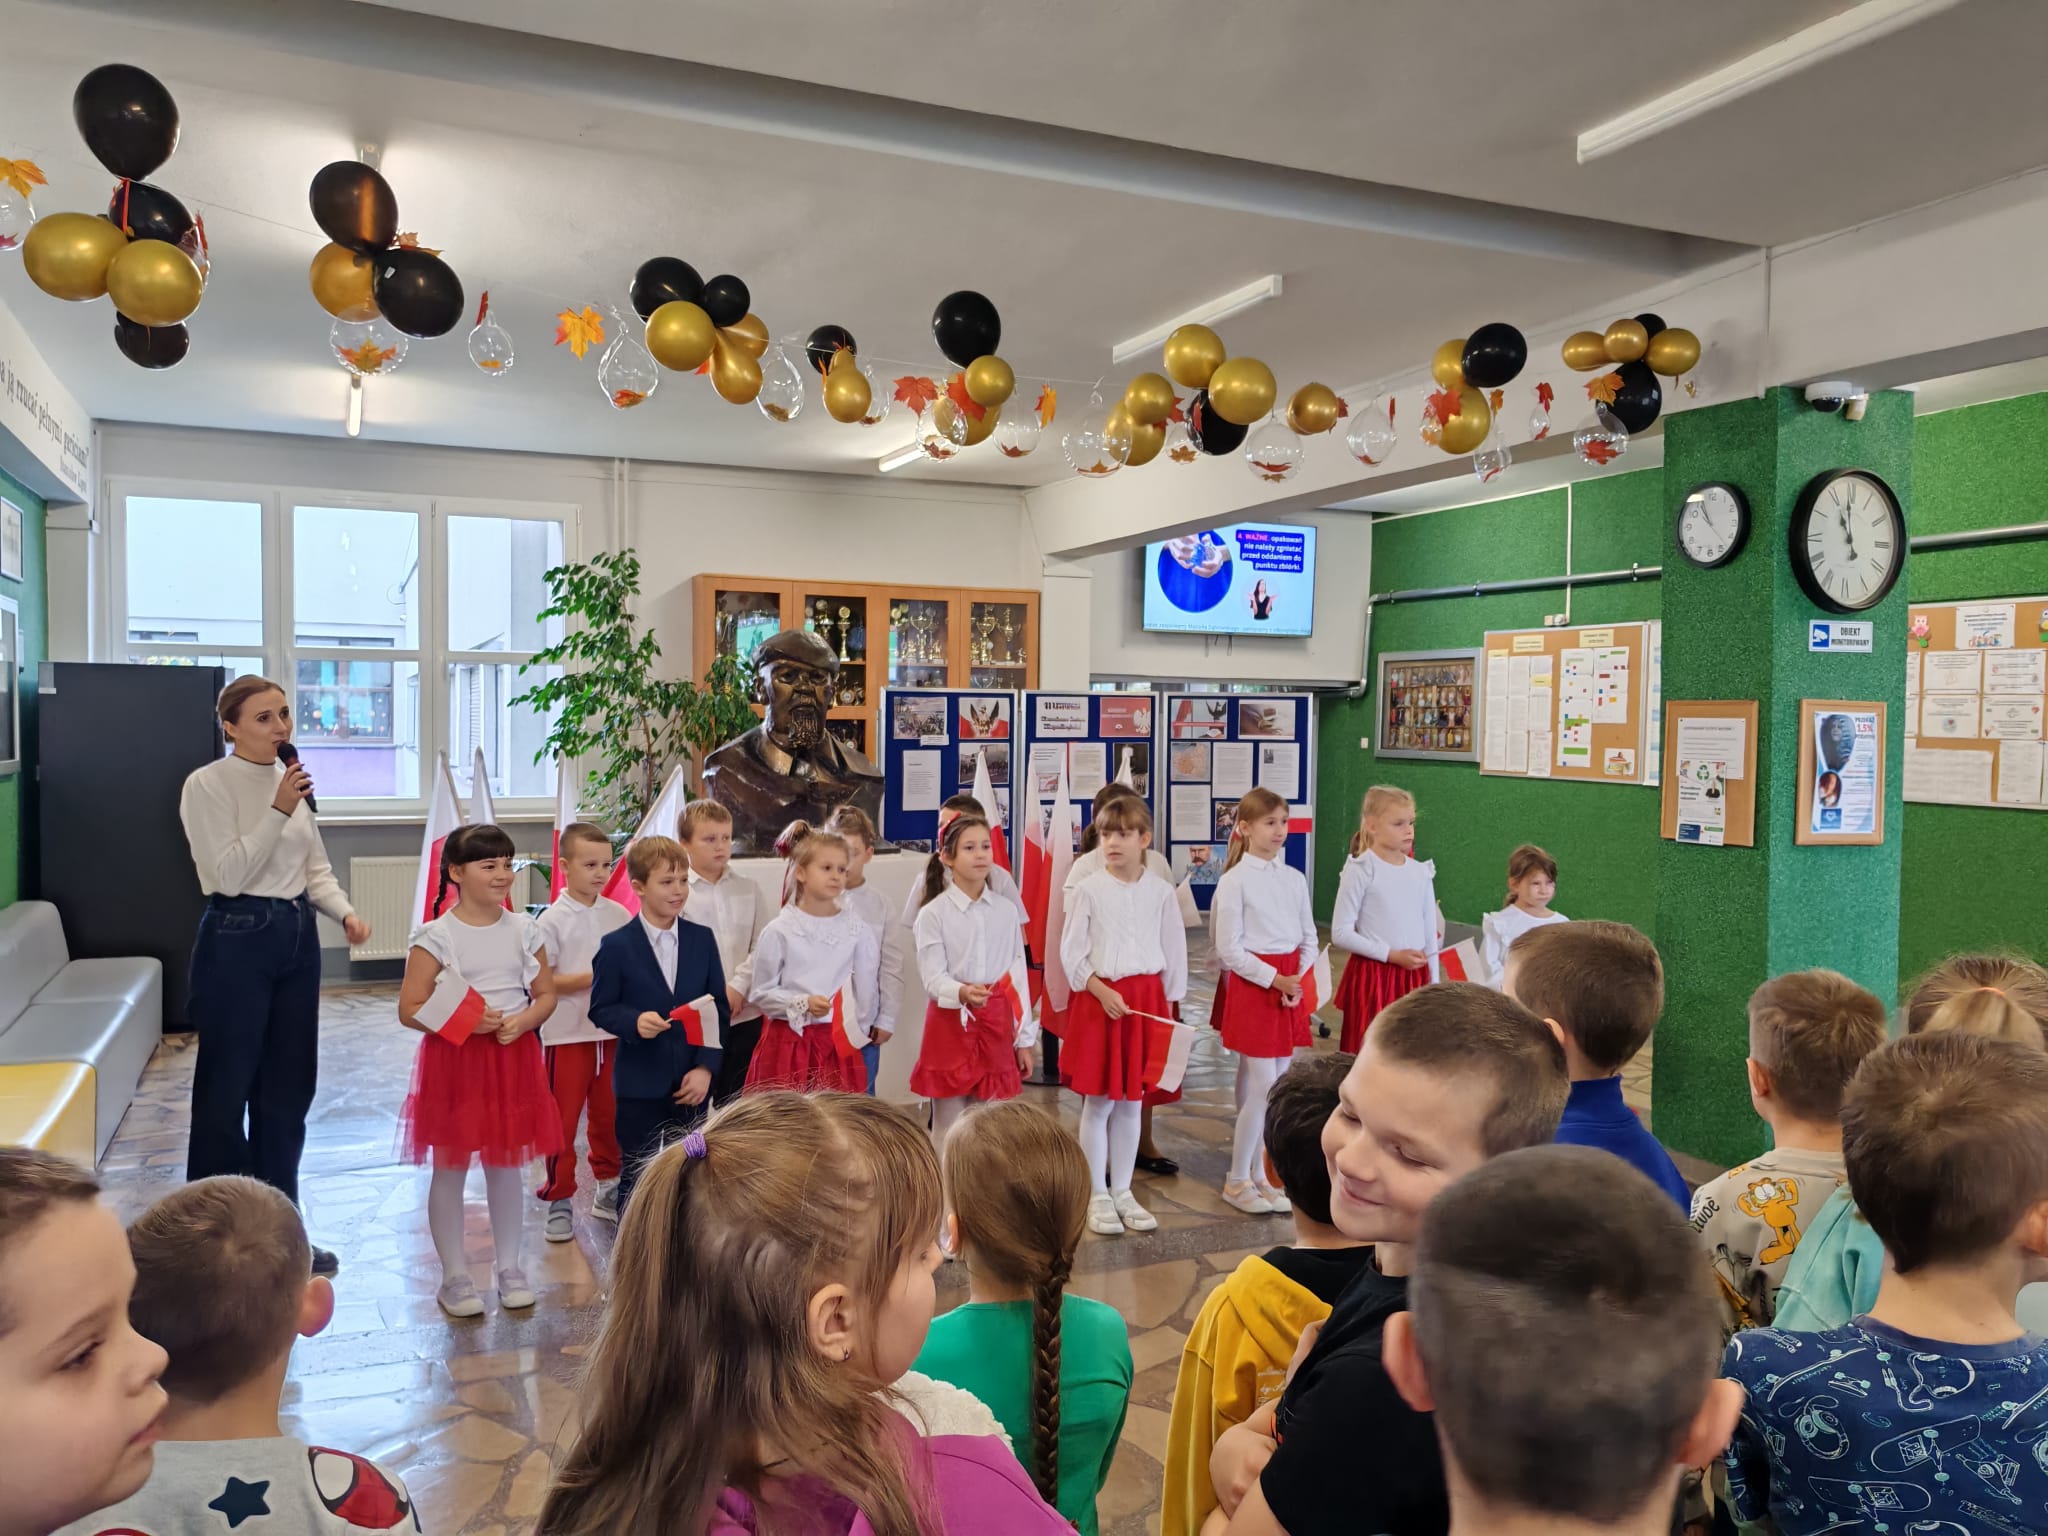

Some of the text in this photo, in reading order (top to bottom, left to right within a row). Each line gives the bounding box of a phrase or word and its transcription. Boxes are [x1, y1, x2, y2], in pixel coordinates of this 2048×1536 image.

[6, 359, 15, 402] ją
[16, 378, 39, 419] rzucać
[38, 401, 63, 445] pełnymi
[1254, 543, 1276, 552] należy
[1242, 552, 1260, 560] przed
[1840, 626, 1861, 636] OBIEKT
